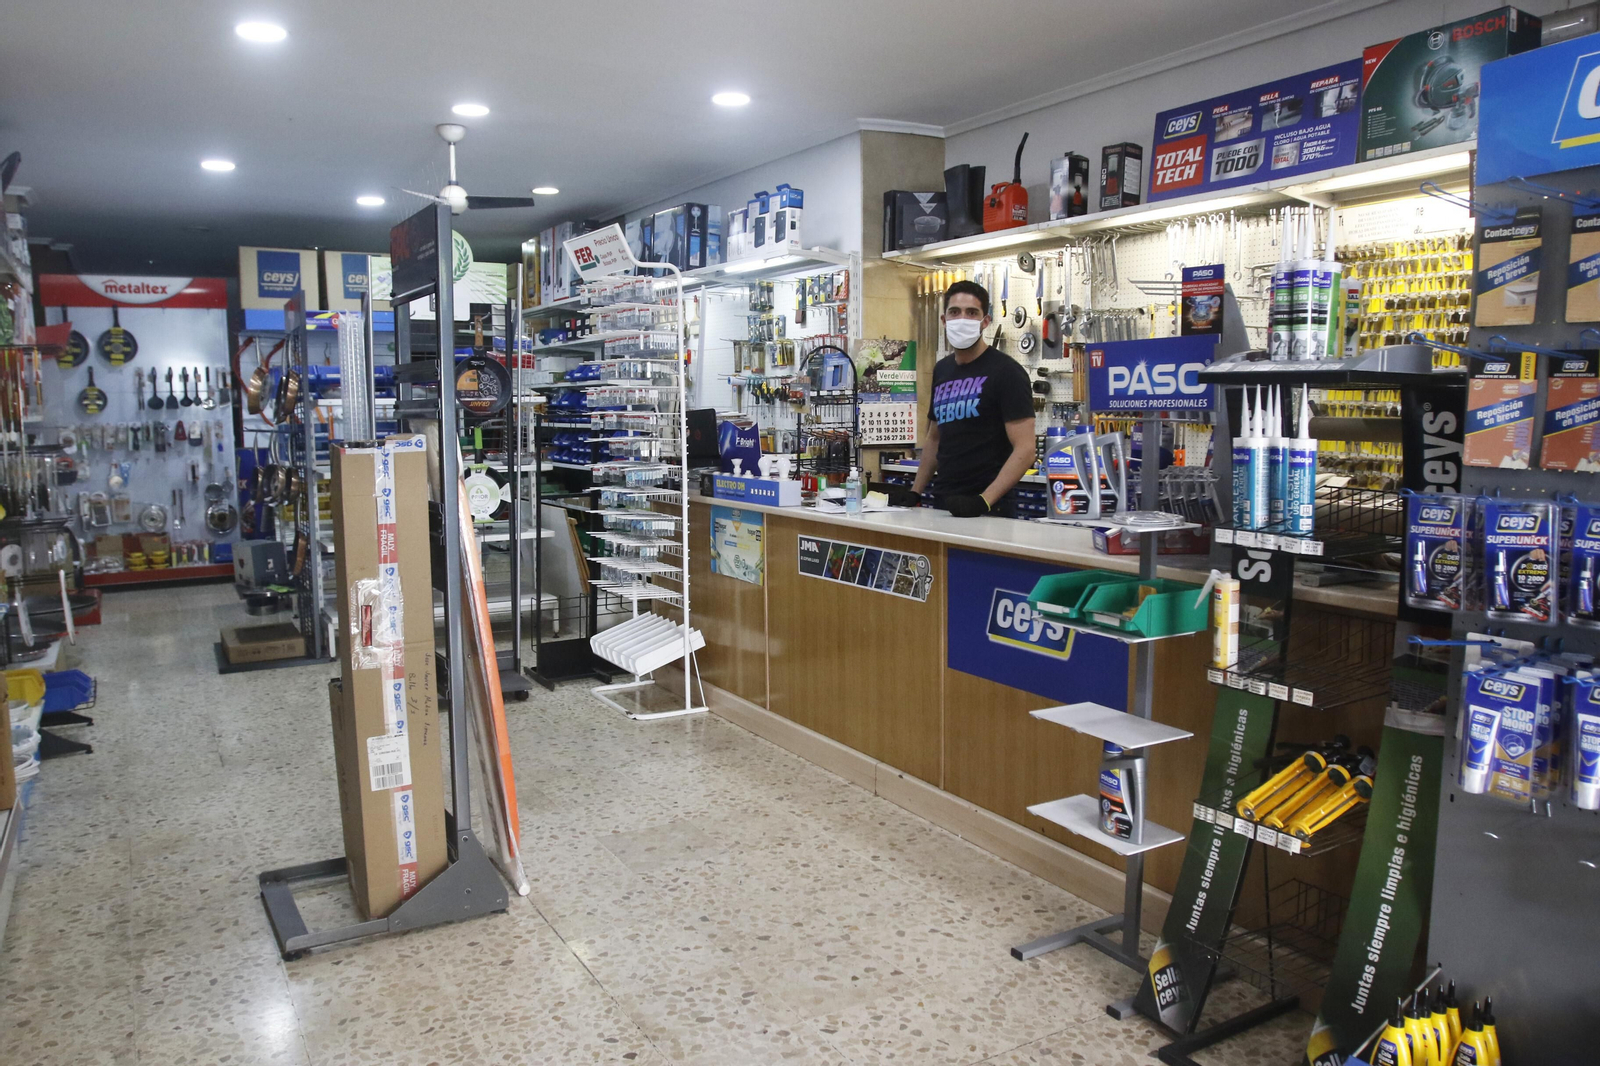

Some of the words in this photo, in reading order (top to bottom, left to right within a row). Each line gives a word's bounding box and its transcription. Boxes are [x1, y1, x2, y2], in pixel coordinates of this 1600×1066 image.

[1452, 15, 1507, 42] BOSCH
[1365, 57, 1377, 66] NEW
[1310, 76, 1339, 88] REPARA
[1260, 92, 1280, 102] SELLA
[1213, 105, 1228, 114] PEGA
[1167, 114, 1197, 134] ceys
[1274, 131, 1297, 140] INCLUSO
[1308, 129, 1330, 138] POTABLE
[1156, 146, 1203, 170] TOTAL
[1217, 148, 1242, 160] PUEDE
[1243, 144, 1261, 154] CON
[1215, 153, 1259, 175] TODO
[1156, 164, 1197, 186] TECH
[574, 246, 594, 265] FER
[1487, 255, 1530, 280] Reposición
[1494, 275, 1504, 285] en
[1505, 266, 1527, 280] breve
[1587, 268, 1598, 278] en
[263, 272, 294, 284] ceys
[104, 282, 169, 296] metaltex
[1092, 356, 1102, 366] TV
[1486, 363, 1506, 372] ceys
[1565, 362, 1585, 371] ceys
[1109, 399, 1148, 408] SOLUCIONES
[1149, 399, 1208, 408] PROFESIONALES
[1476, 401, 1523, 420] Reposición
[1555, 400, 1600, 420] Reposición
[1484, 416, 1494, 426] en
[1496, 410, 1520, 422] breve
[1562, 417, 1572, 427] en
[1575, 410, 1598, 423] breve
[716, 479, 736, 490] ELECTRO
[1421, 508, 1451, 522] ceys
[1500, 516, 1535, 531] ceys
[380, 530, 388, 558] FRAGIL
[800, 540, 819, 553] JMA
[1484, 680, 1520, 696] ceys
[1474, 714, 1492, 724] ceys
[1503, 706, 1535, 723] STOP
[1471, 723, 1491, 734] STOP
[1502, 718, 1533, 733] MOHO
[1101, 774, 1118, 786] PASO
[1396, 755, 1422, 830] higiénicas
[402, 805, 410, 822] gsc
[1185, 890, 1206, 934] Juntas
[1201, 836, 1221, 889] siempre
[1227, 709, 1248, 774] higiénicas
[1397, 834, 1408, 843] e
[404, 841, 413, 858] gsc
[402, 869, 410, 895] FRAGIL
[1381, 851, 1405, 901] limpias
[1368, 903, 1392, 962] siempre
[1351, 964, 1376, 1014] Juntas
